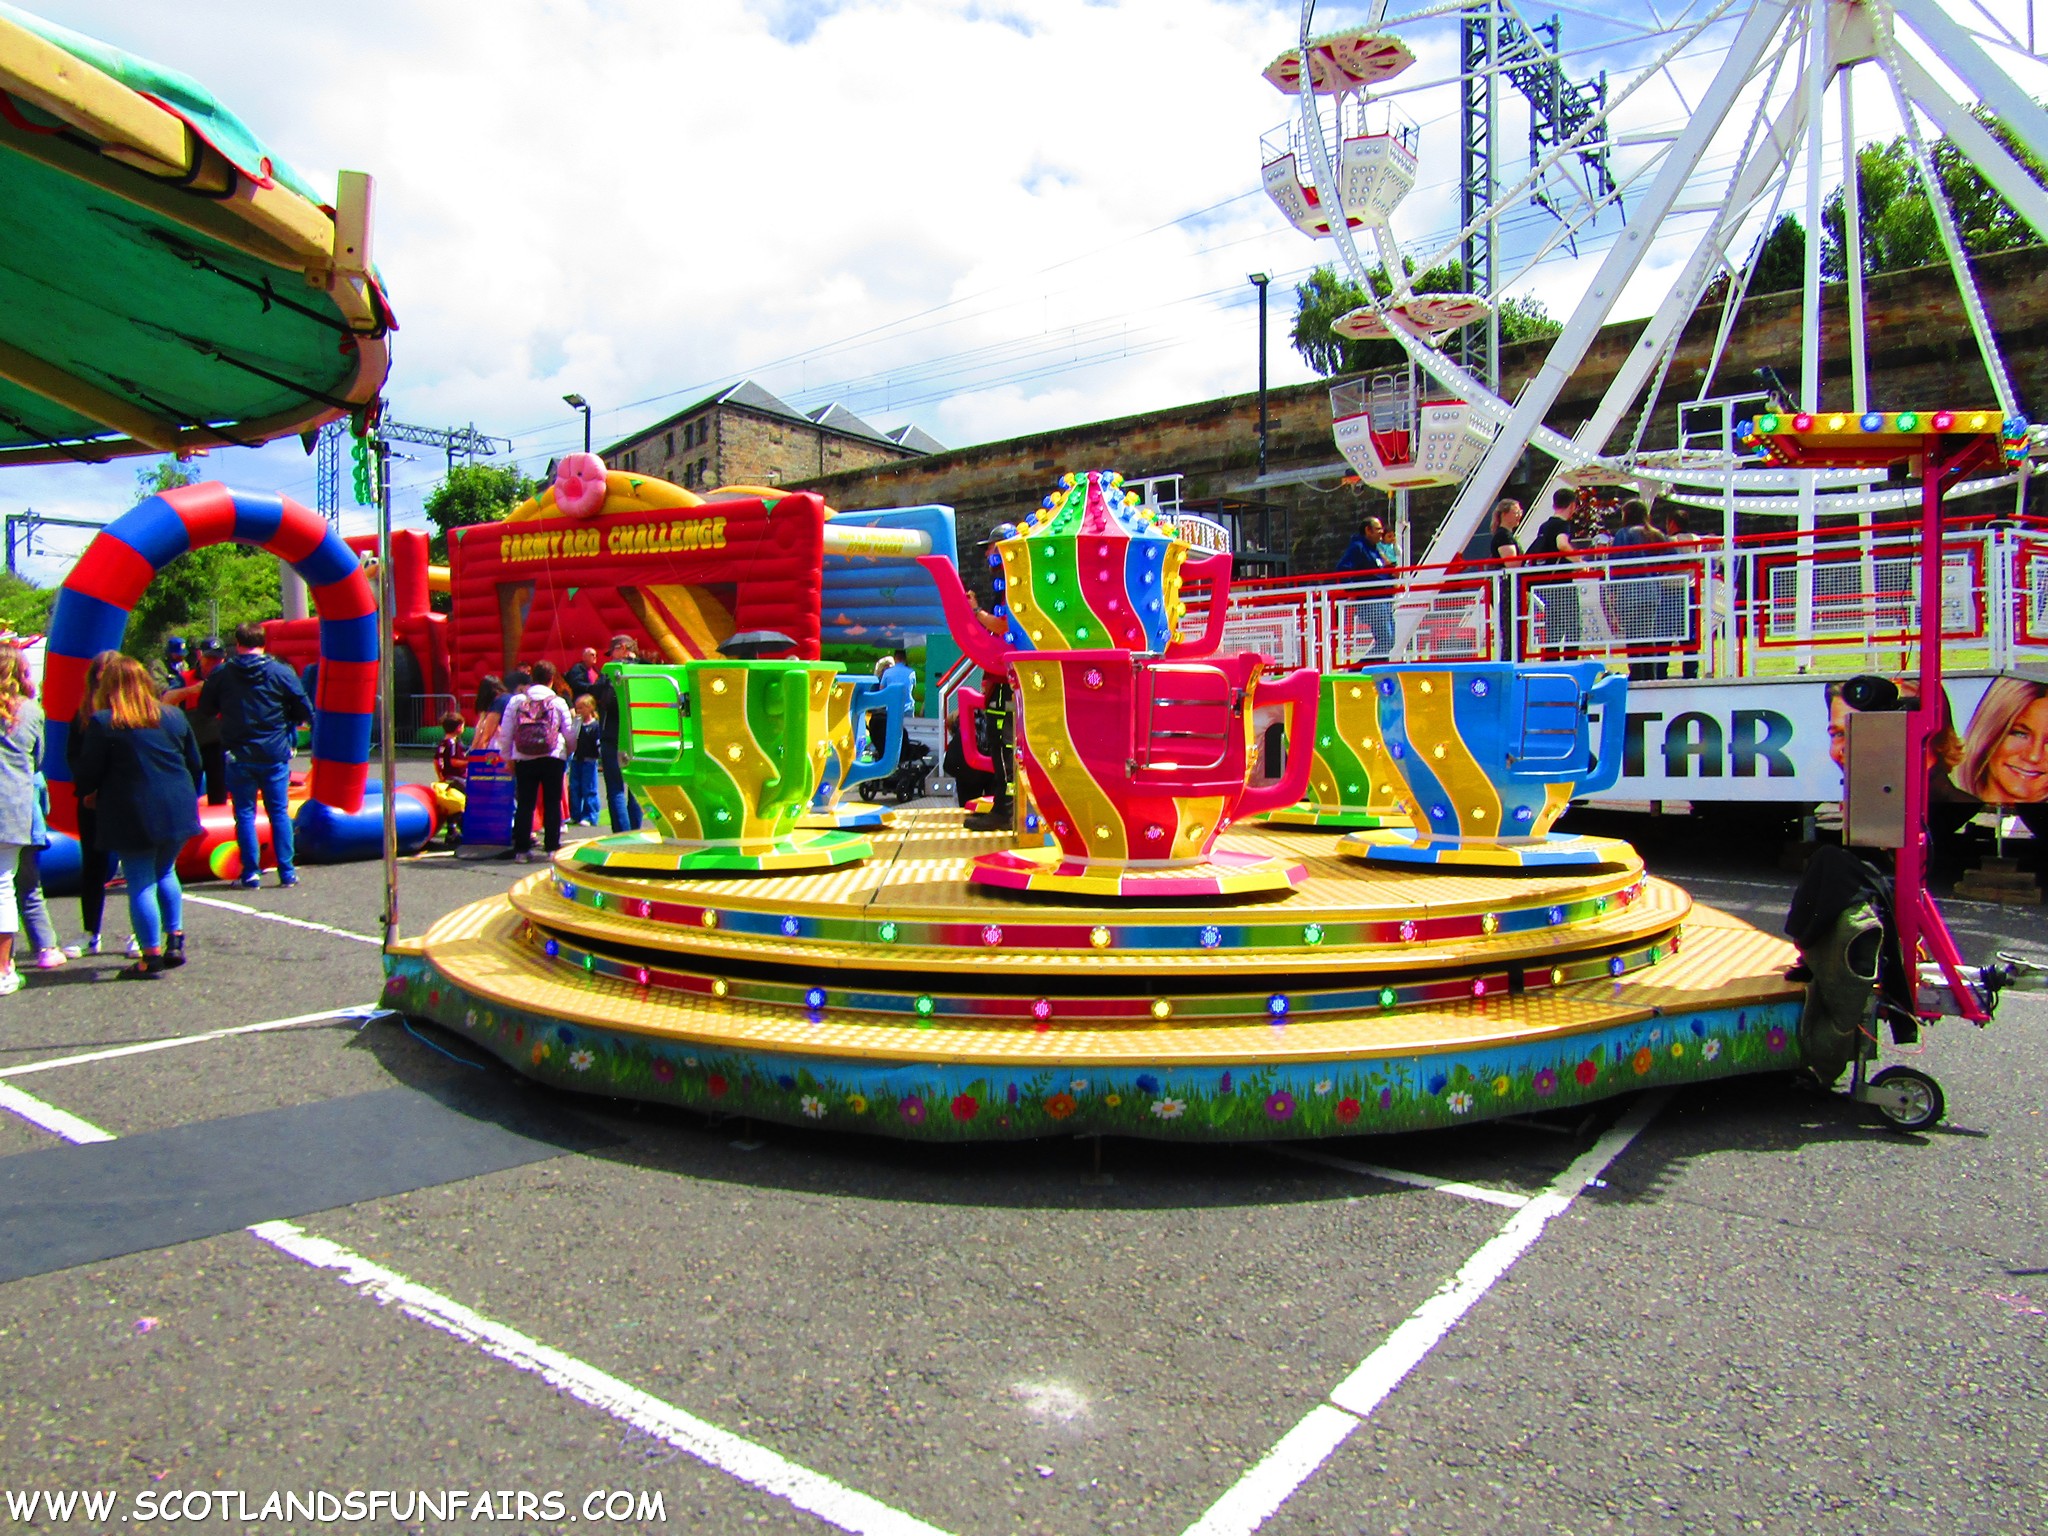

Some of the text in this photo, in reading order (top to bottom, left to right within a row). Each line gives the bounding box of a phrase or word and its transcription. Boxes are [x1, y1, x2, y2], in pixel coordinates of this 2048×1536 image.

[500, 516, 727, 563] FARMYARD CHALLENGE
[1587, 709, 1795, 777] TAR
